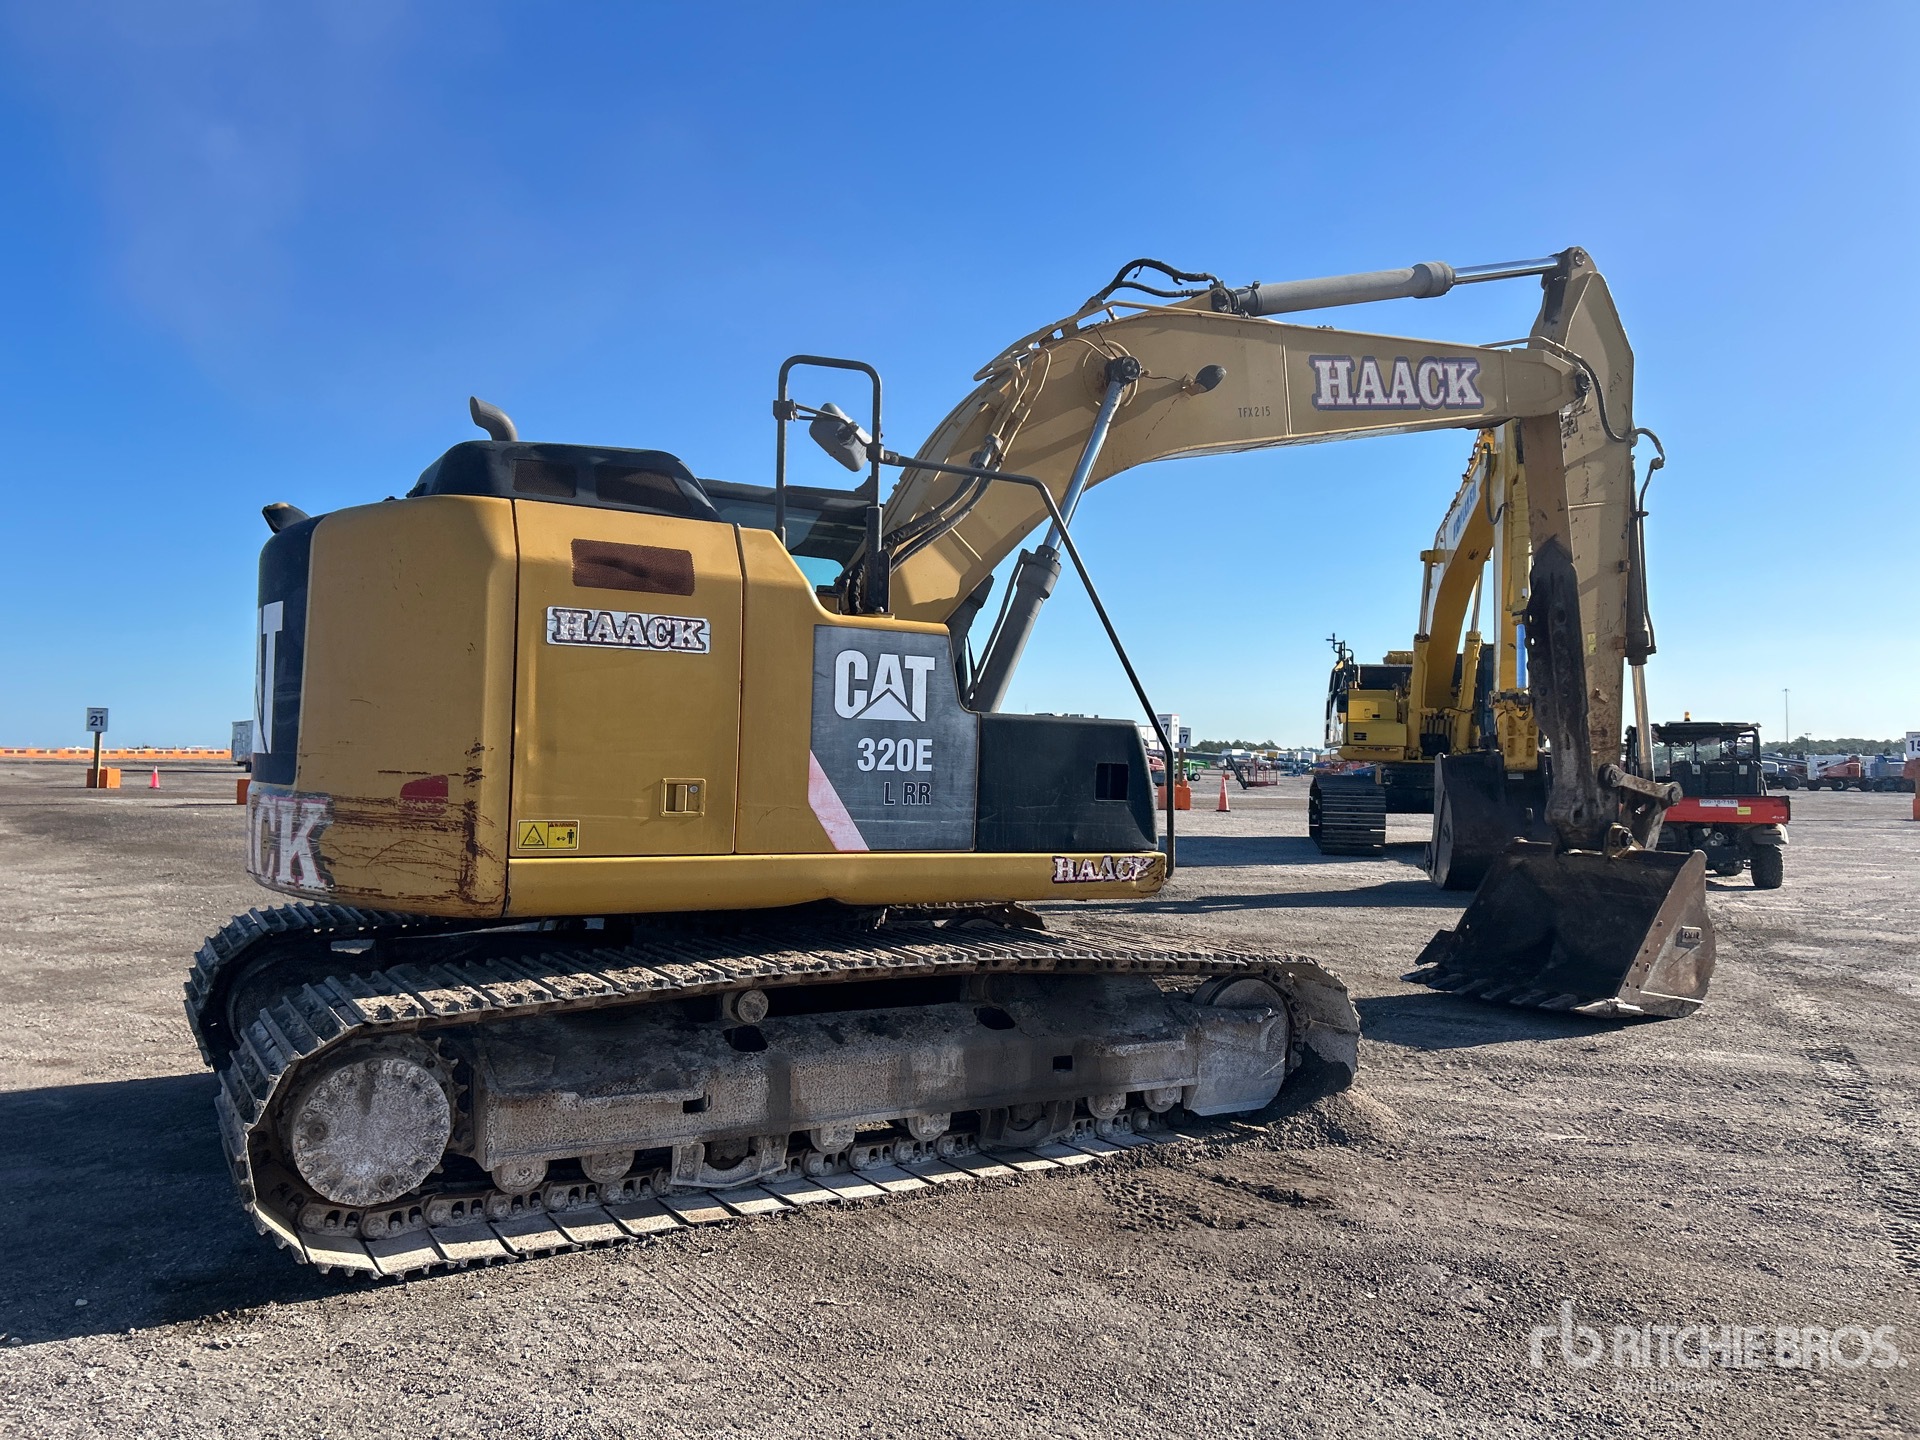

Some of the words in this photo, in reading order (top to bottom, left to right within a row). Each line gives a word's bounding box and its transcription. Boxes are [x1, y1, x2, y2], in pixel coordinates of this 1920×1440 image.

[1310, 355, 1484, 410] HAACK
[1238, 406, 1271, 418] TFX215
[552, 608, 707, 652] HAACK
[834, 649, 936, 722] CAT
[90, 715, 104, 726] 21
[1179, 734, 1189, 744] 17
[857, 737, 933, 772] 320E
[883, 781, 896, 806] L
[902, 781, 932, 806] RR
